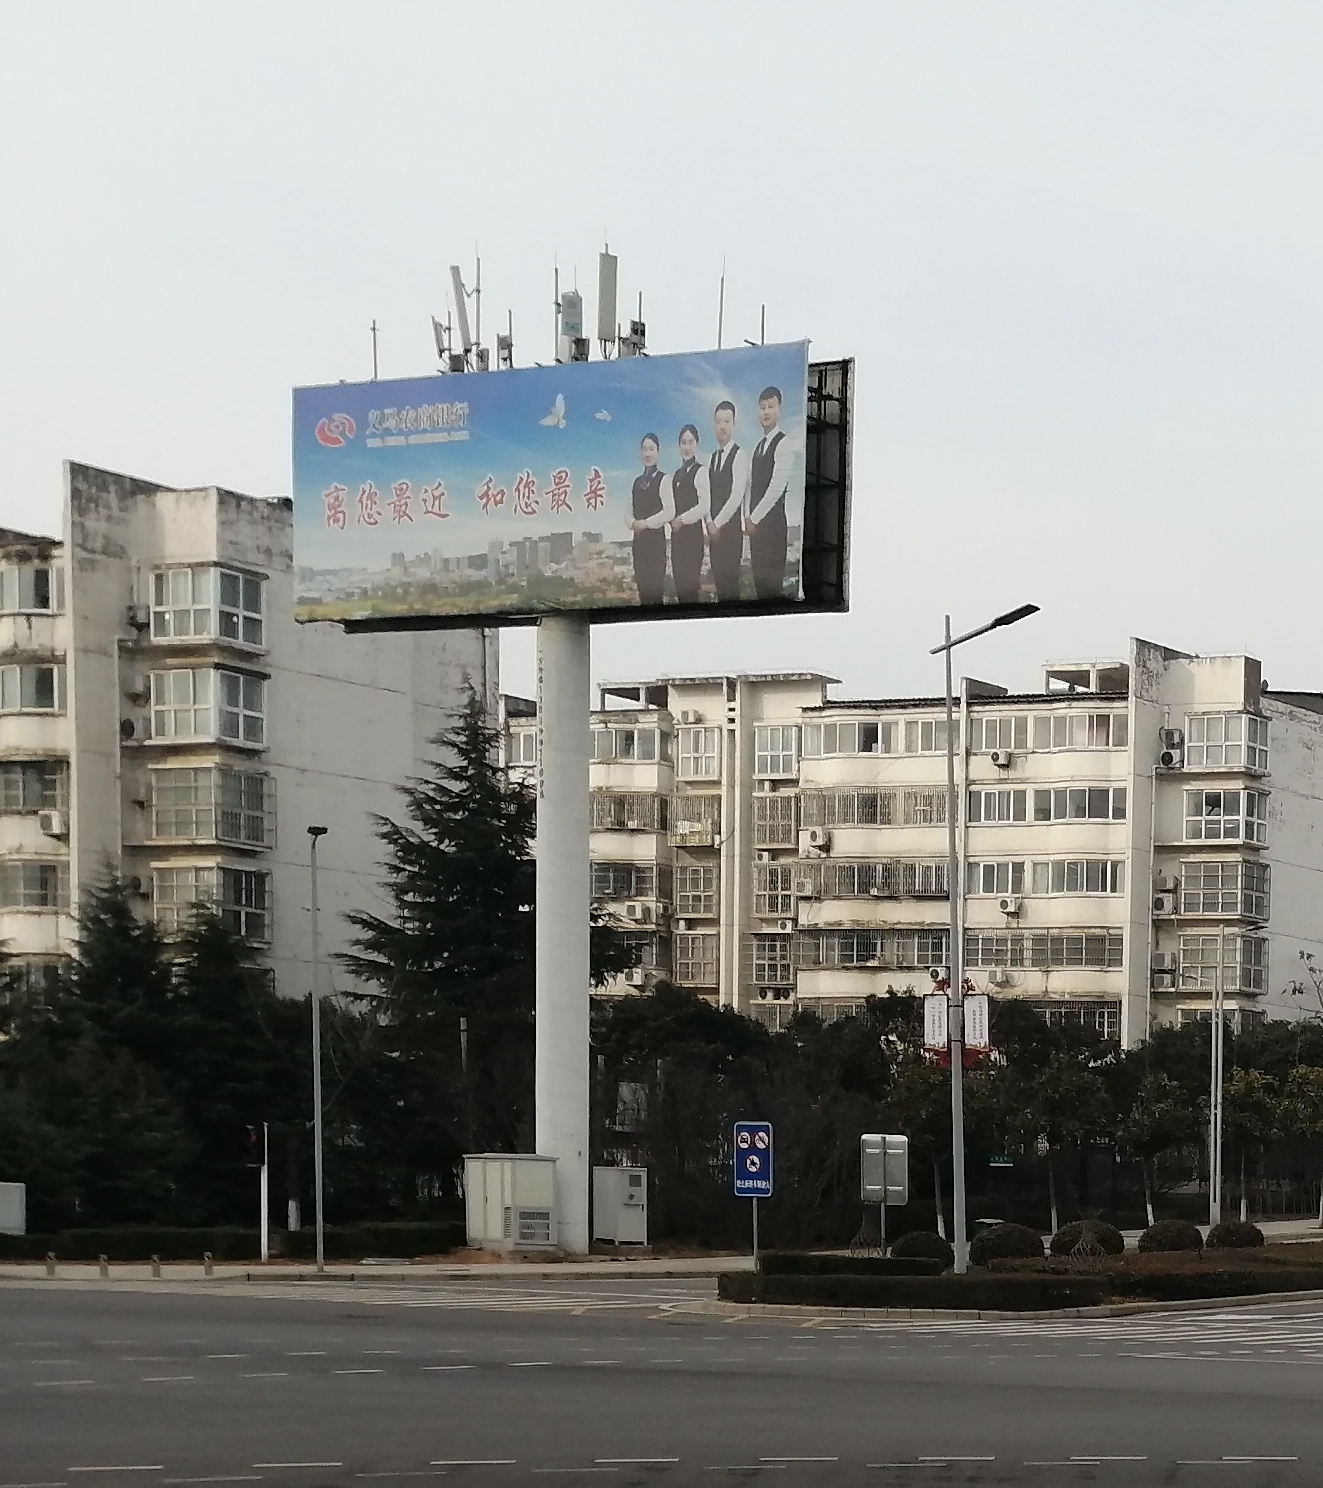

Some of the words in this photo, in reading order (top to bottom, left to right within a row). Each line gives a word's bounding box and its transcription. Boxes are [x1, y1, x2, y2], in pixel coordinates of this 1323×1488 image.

[324, 480, 451, 531] 离您最近
[476, 468, 606, 516] 和您最亲
